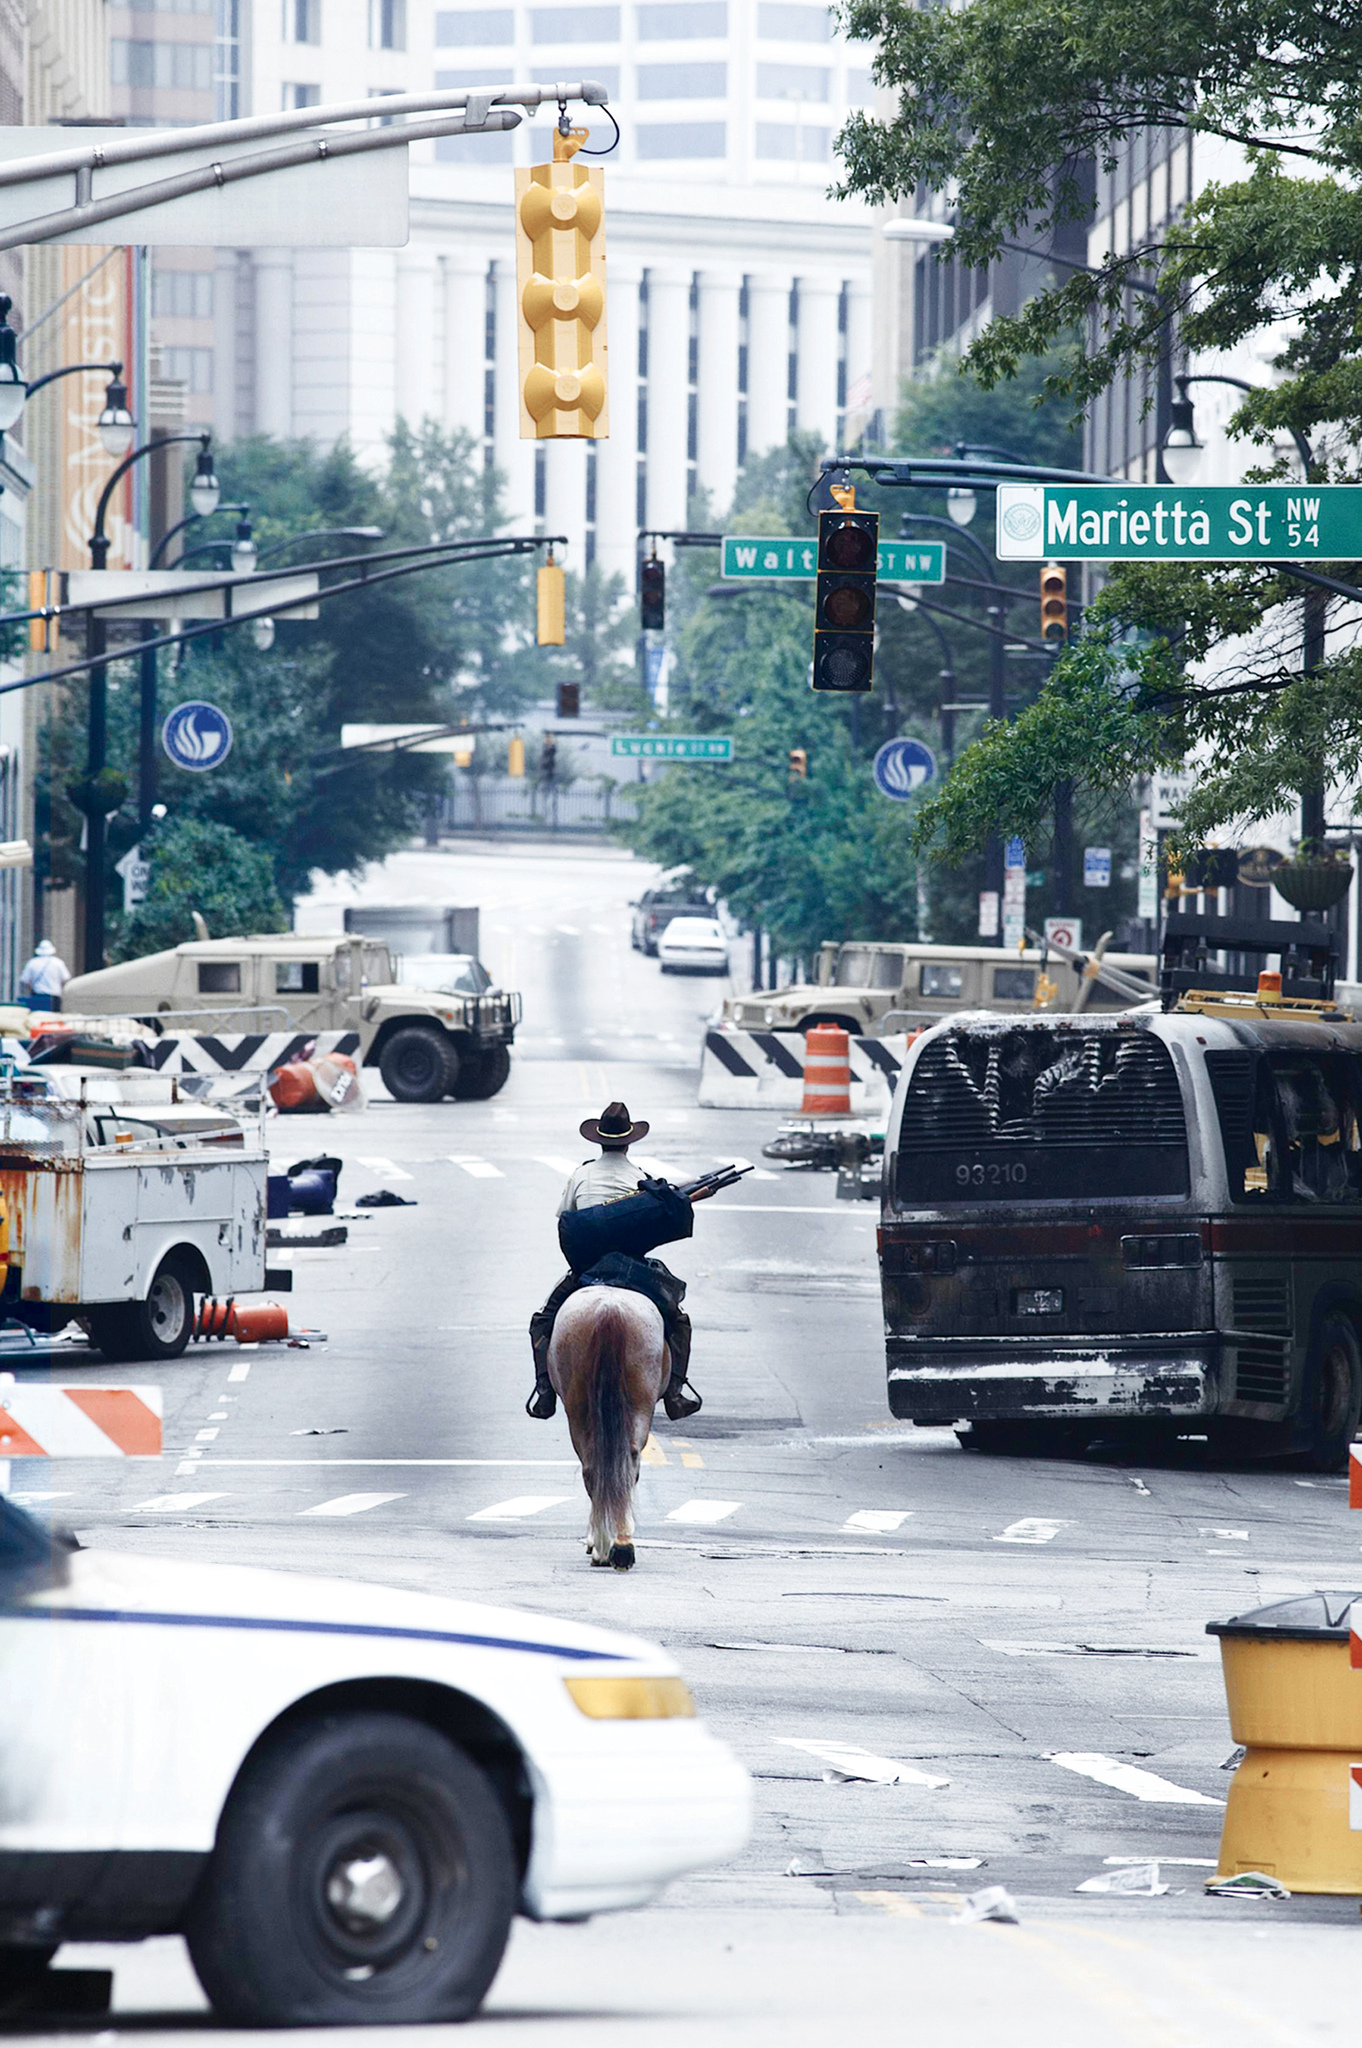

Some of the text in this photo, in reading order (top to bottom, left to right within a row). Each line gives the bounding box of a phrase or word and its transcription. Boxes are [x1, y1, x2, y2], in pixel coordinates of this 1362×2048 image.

[68, 278, 117, 471] Music
[1048, 499, 1210, 546] Marietta
[1227, 499, 1272, 546] St
[1286, 498, 1321, 522] NW
[1287, 523, 1320, 548] 54
[735, 546, 932, 571] Walt ST NW
[1158, 786, 1190, 800] WAY
[956, 1163, 1027, 1186] 93210
